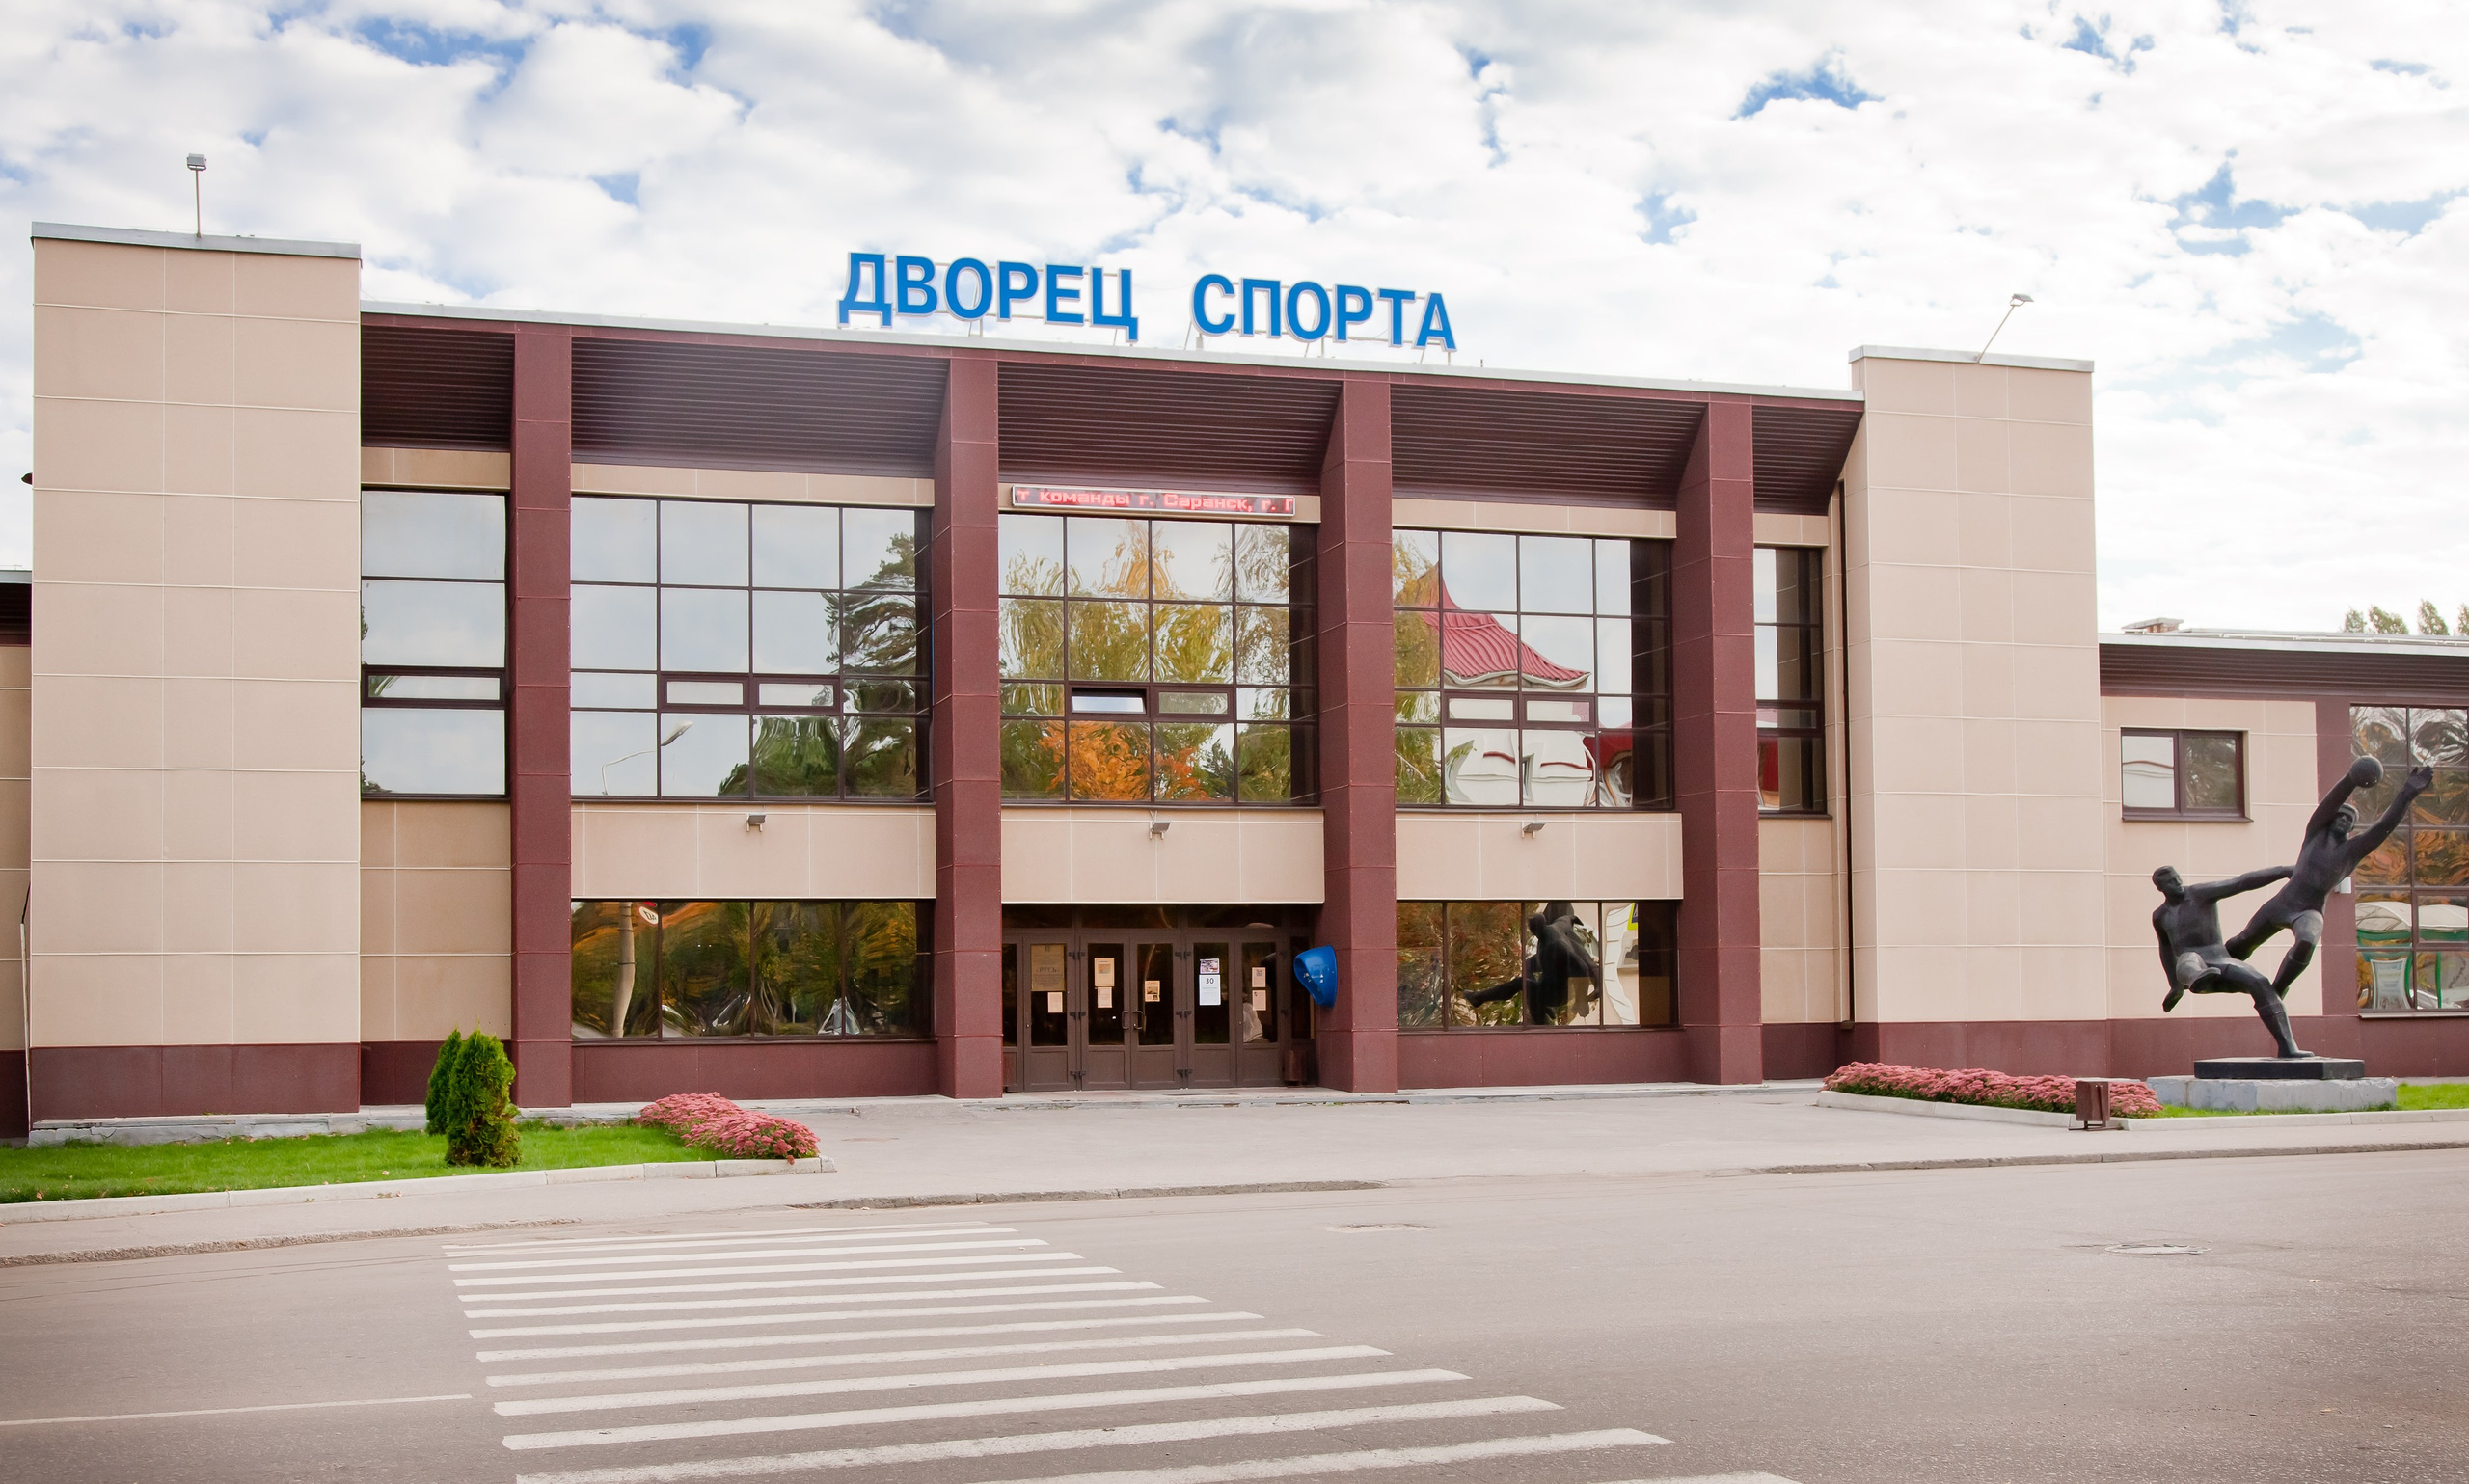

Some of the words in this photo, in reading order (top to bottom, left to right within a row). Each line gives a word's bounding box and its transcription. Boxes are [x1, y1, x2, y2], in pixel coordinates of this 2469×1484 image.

[837, 252, 1139, 342] ДВОРЕЦ
[1192, 273, 1457, 352] СПОРТА
[1039, 490, 1131, 506] команды
[1138, 494, 1155, 506] г.
[1163, 493, 1253, 512] Саранск,
